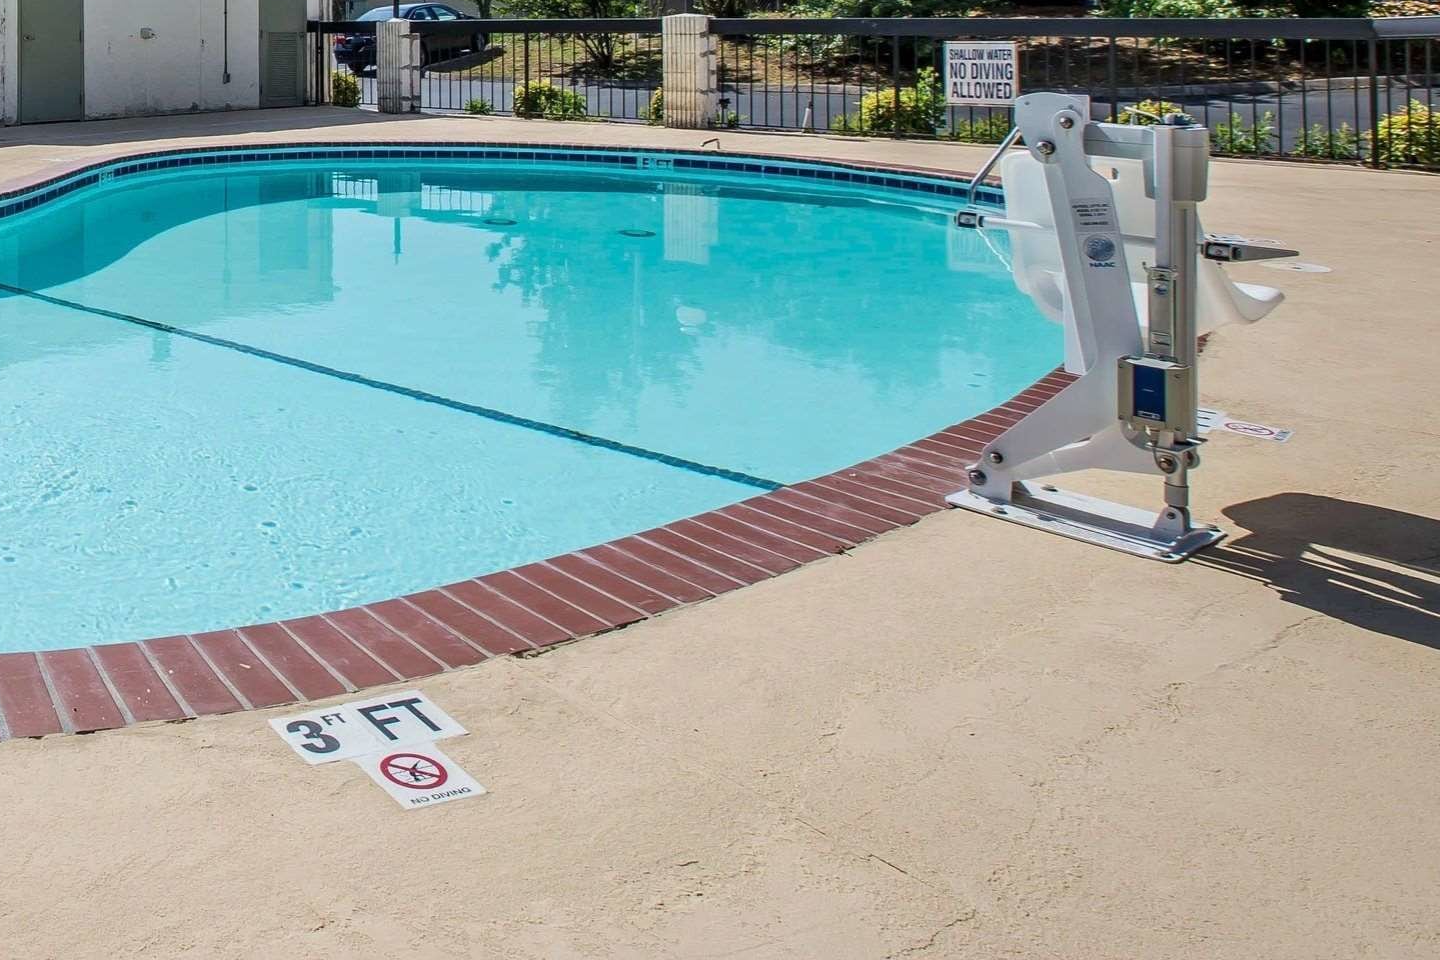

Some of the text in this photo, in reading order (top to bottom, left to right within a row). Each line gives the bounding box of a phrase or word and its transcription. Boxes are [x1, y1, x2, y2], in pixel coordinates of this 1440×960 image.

[949, 49, 1012, 60] SHALLOW WATER
[950, 62, 1013, 80] NO DIVING
[952, 82, 1012, 99] ALLOWED
[357, 697, 442, 741] FT
[410, 786, 472, 805] NO DIVING
